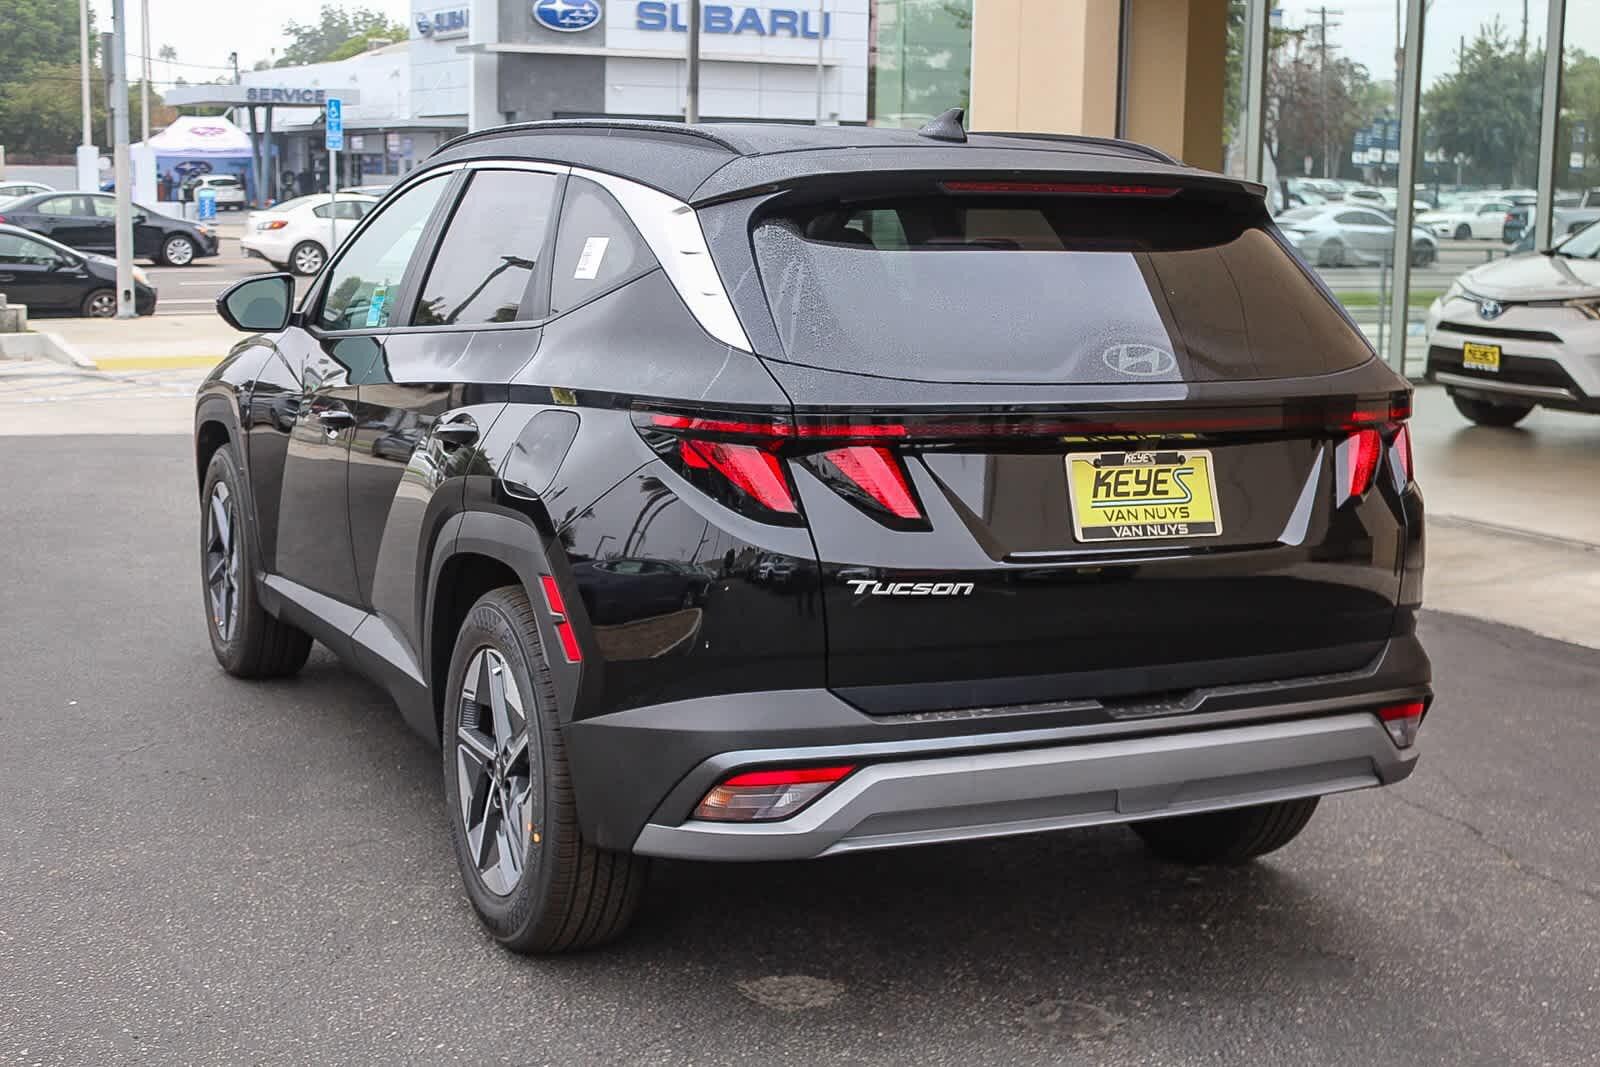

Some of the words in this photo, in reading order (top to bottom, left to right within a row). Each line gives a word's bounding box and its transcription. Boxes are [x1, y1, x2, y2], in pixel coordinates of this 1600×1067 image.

[247, 88, 325, 103] SERVICE
[1124, 453, 1156, 464] KEYES
[1092, 467, 1194, 505] KEYES
[1104, 508, 1139, 522] VAN
[1144, 507, 1190, 520] NUYS
[1112, 525, 1143, 538] VAN
[1147, 524, 1188, 536] NUYS
